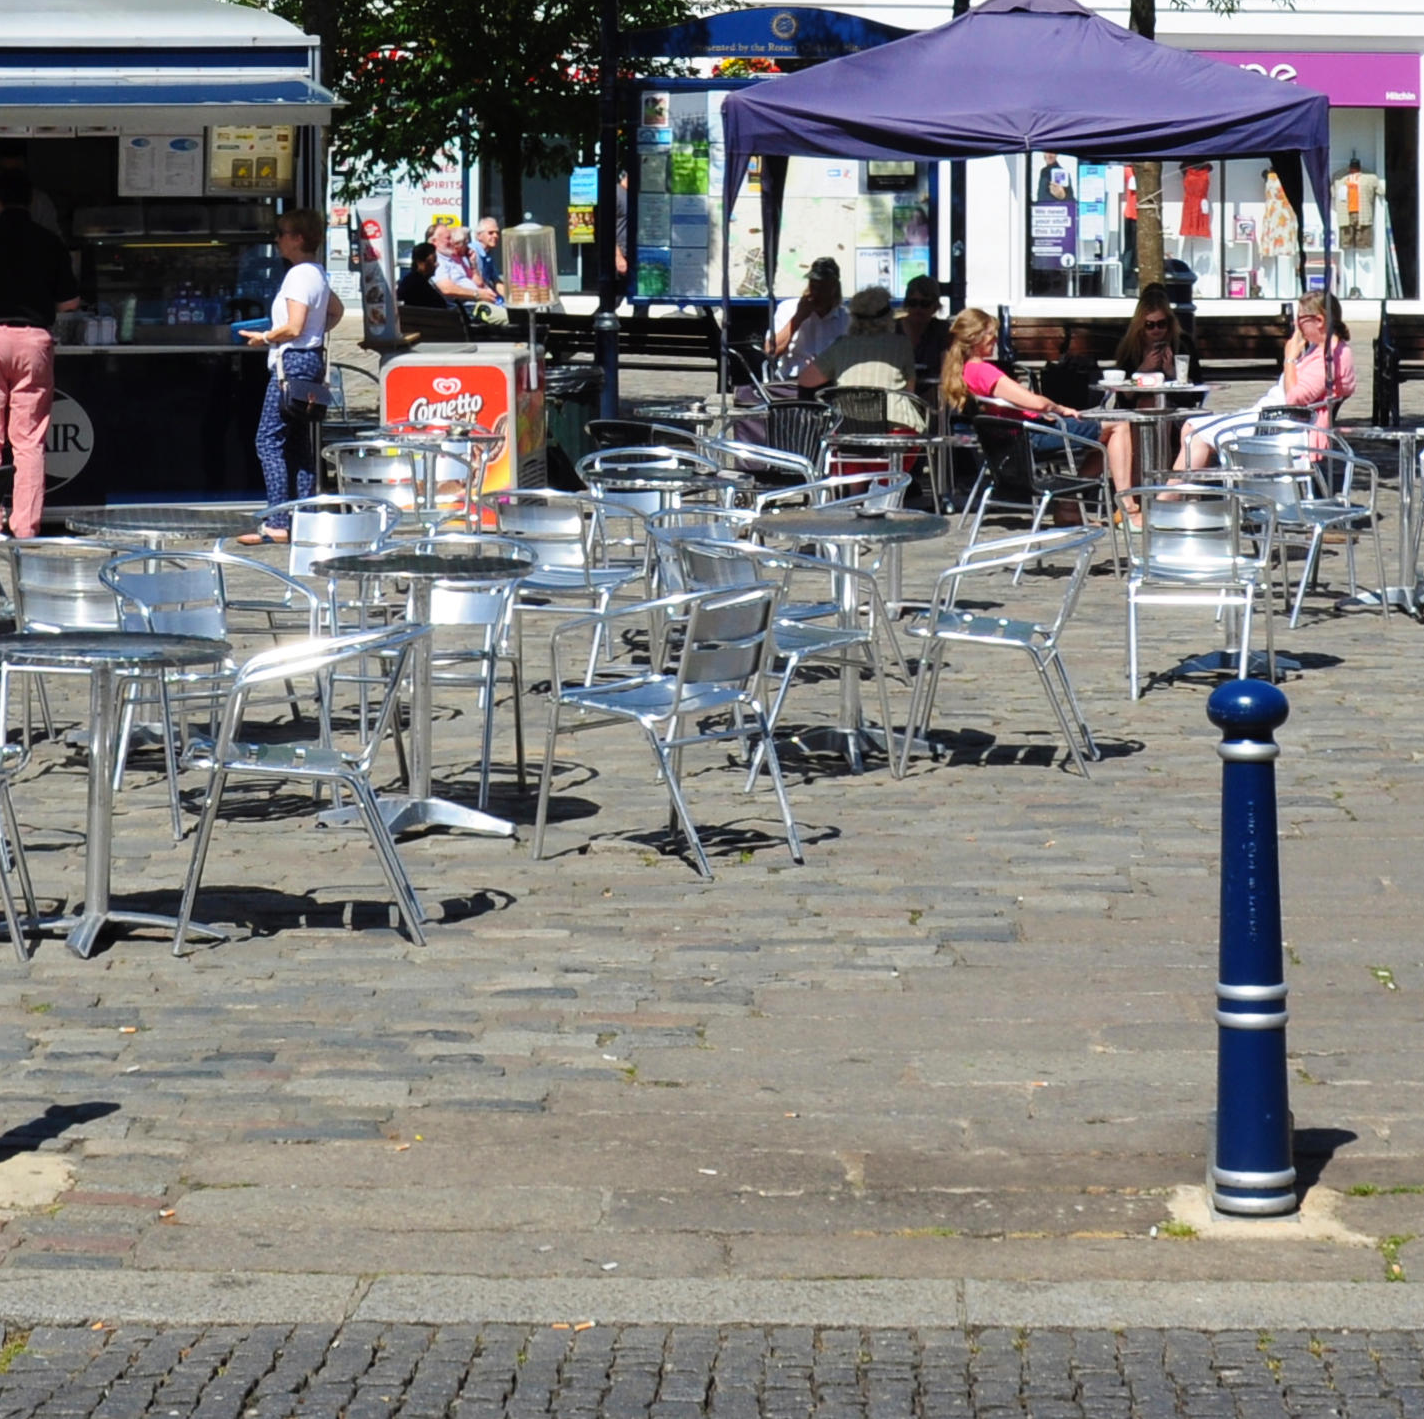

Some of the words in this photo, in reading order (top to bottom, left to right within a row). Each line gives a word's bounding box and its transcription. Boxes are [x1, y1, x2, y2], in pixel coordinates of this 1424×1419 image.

[750, 44, 765, 52] the
[768, 43, 797, 53] Rotary
[1385, 91, 1417, 101] Hitchin
[422, 181, 463, 190] SPIRITS
[422, 197, 463, 206] TOBACC
[408, 392, 483, 424] Cornetto
[42, 423, 91, 453] IR
